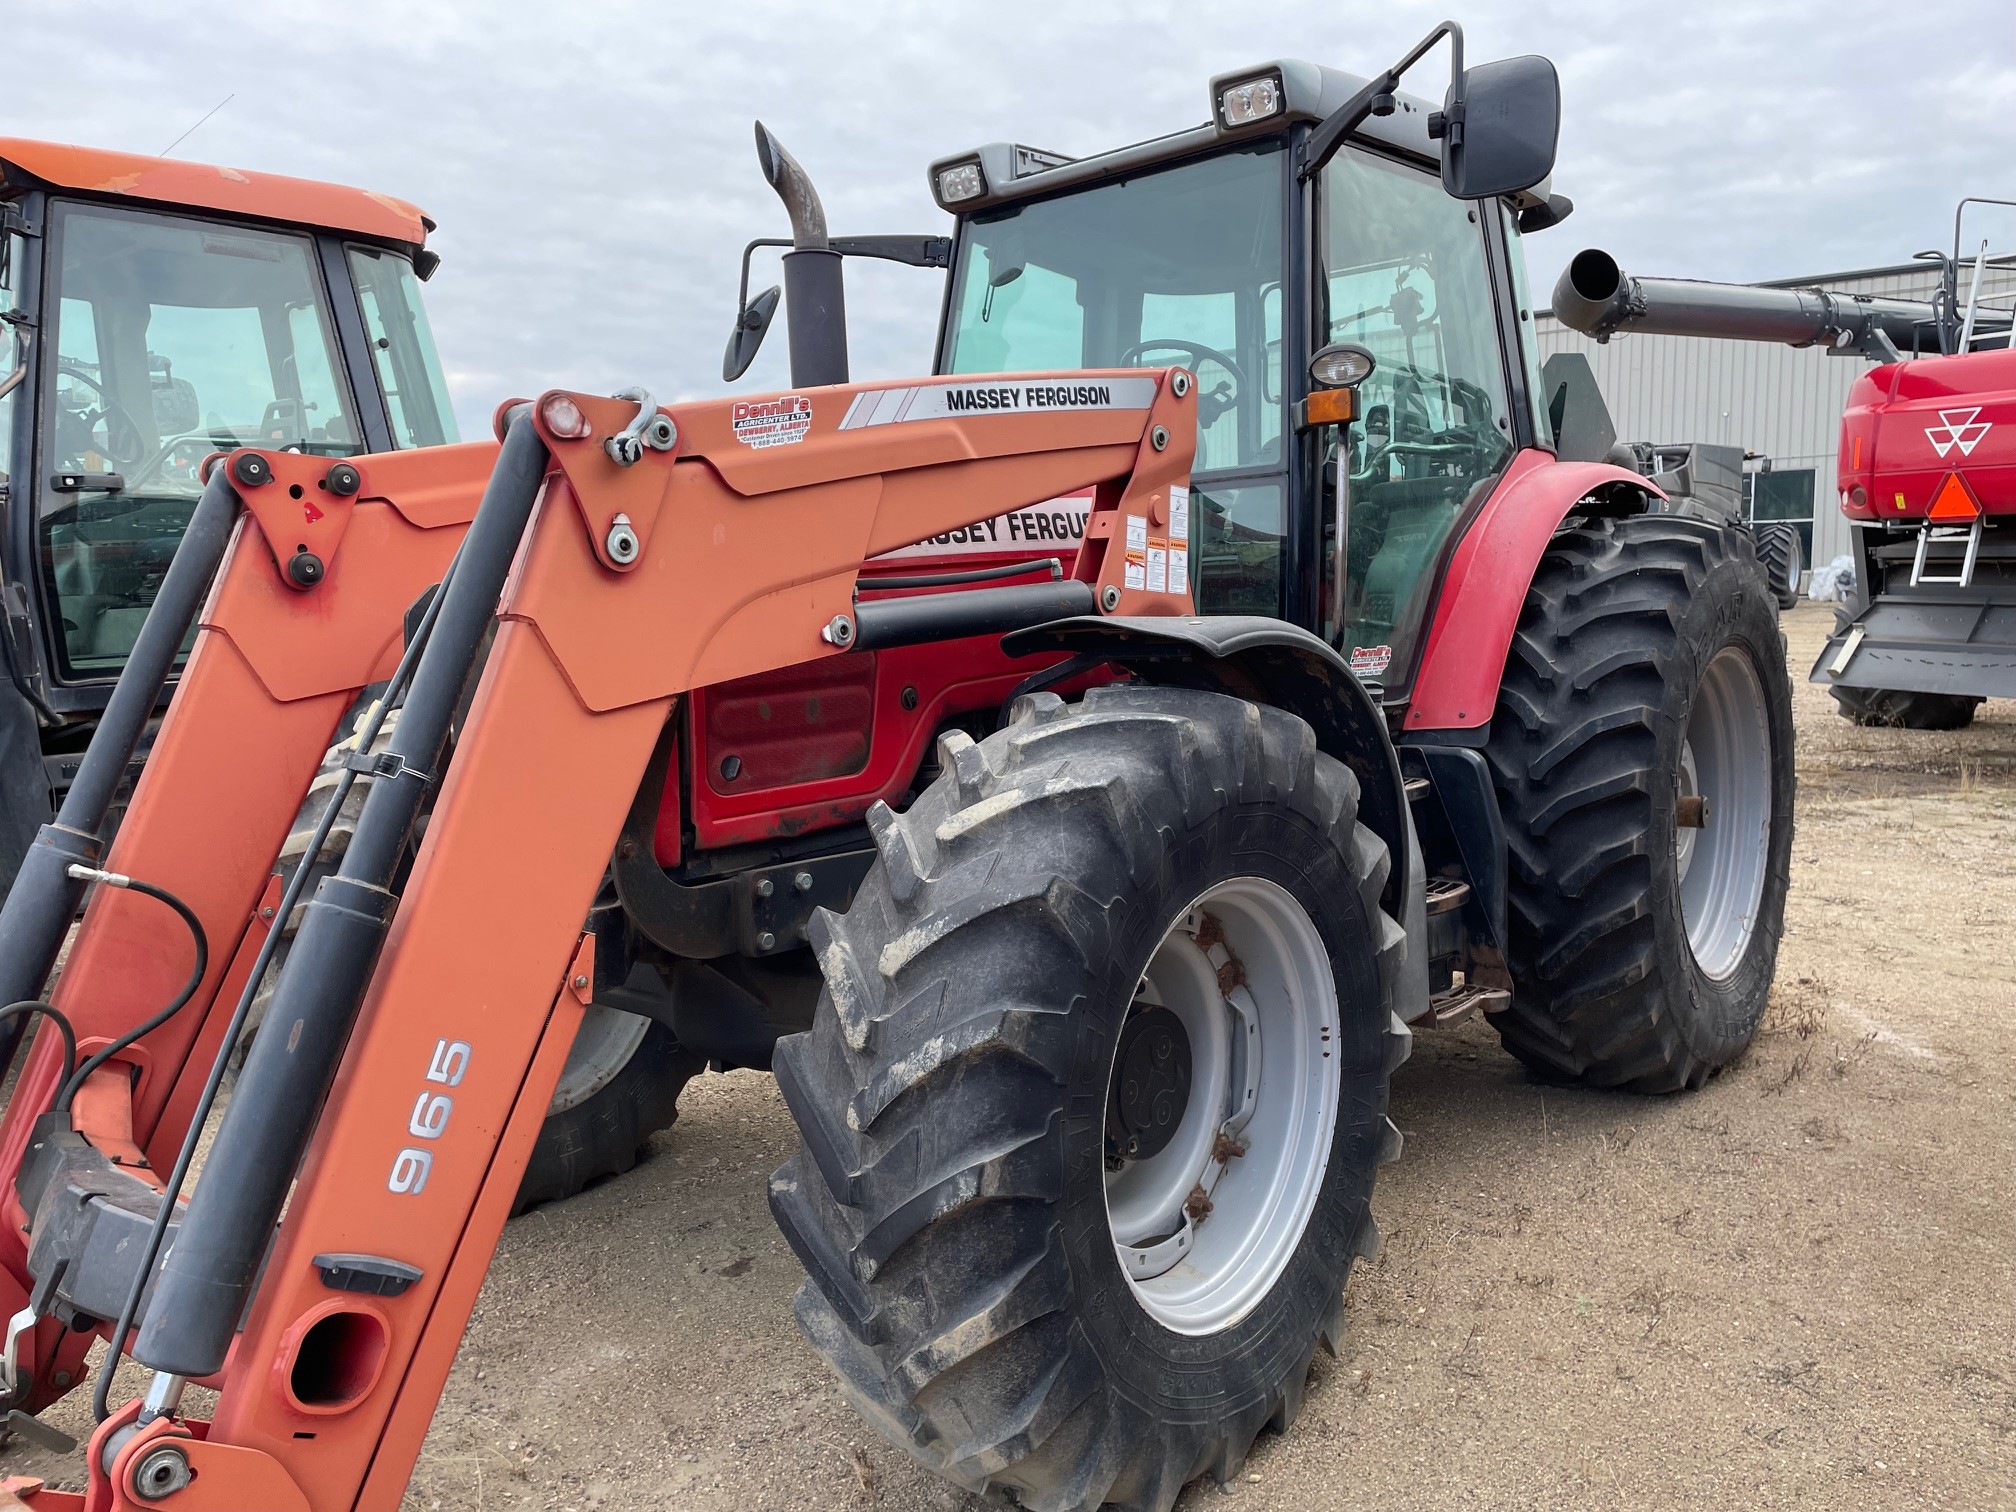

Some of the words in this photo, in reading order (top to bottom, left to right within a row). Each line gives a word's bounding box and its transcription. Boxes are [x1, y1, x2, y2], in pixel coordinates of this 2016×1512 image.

[734, 397, 809, 419] Dennill's
[946, 388, 1019, 411] MASSEY
[1026, 387, 1110, 407] FERGUSON
[738, 415, 789, 428] AGRICENTER
[791, 413, 808, 421] LTD.
[739, 425, 779, 437] DEWBERRY,
[780, 421, 809, 431] ALBERTA
[388, 1037, 473, 1196] 965
